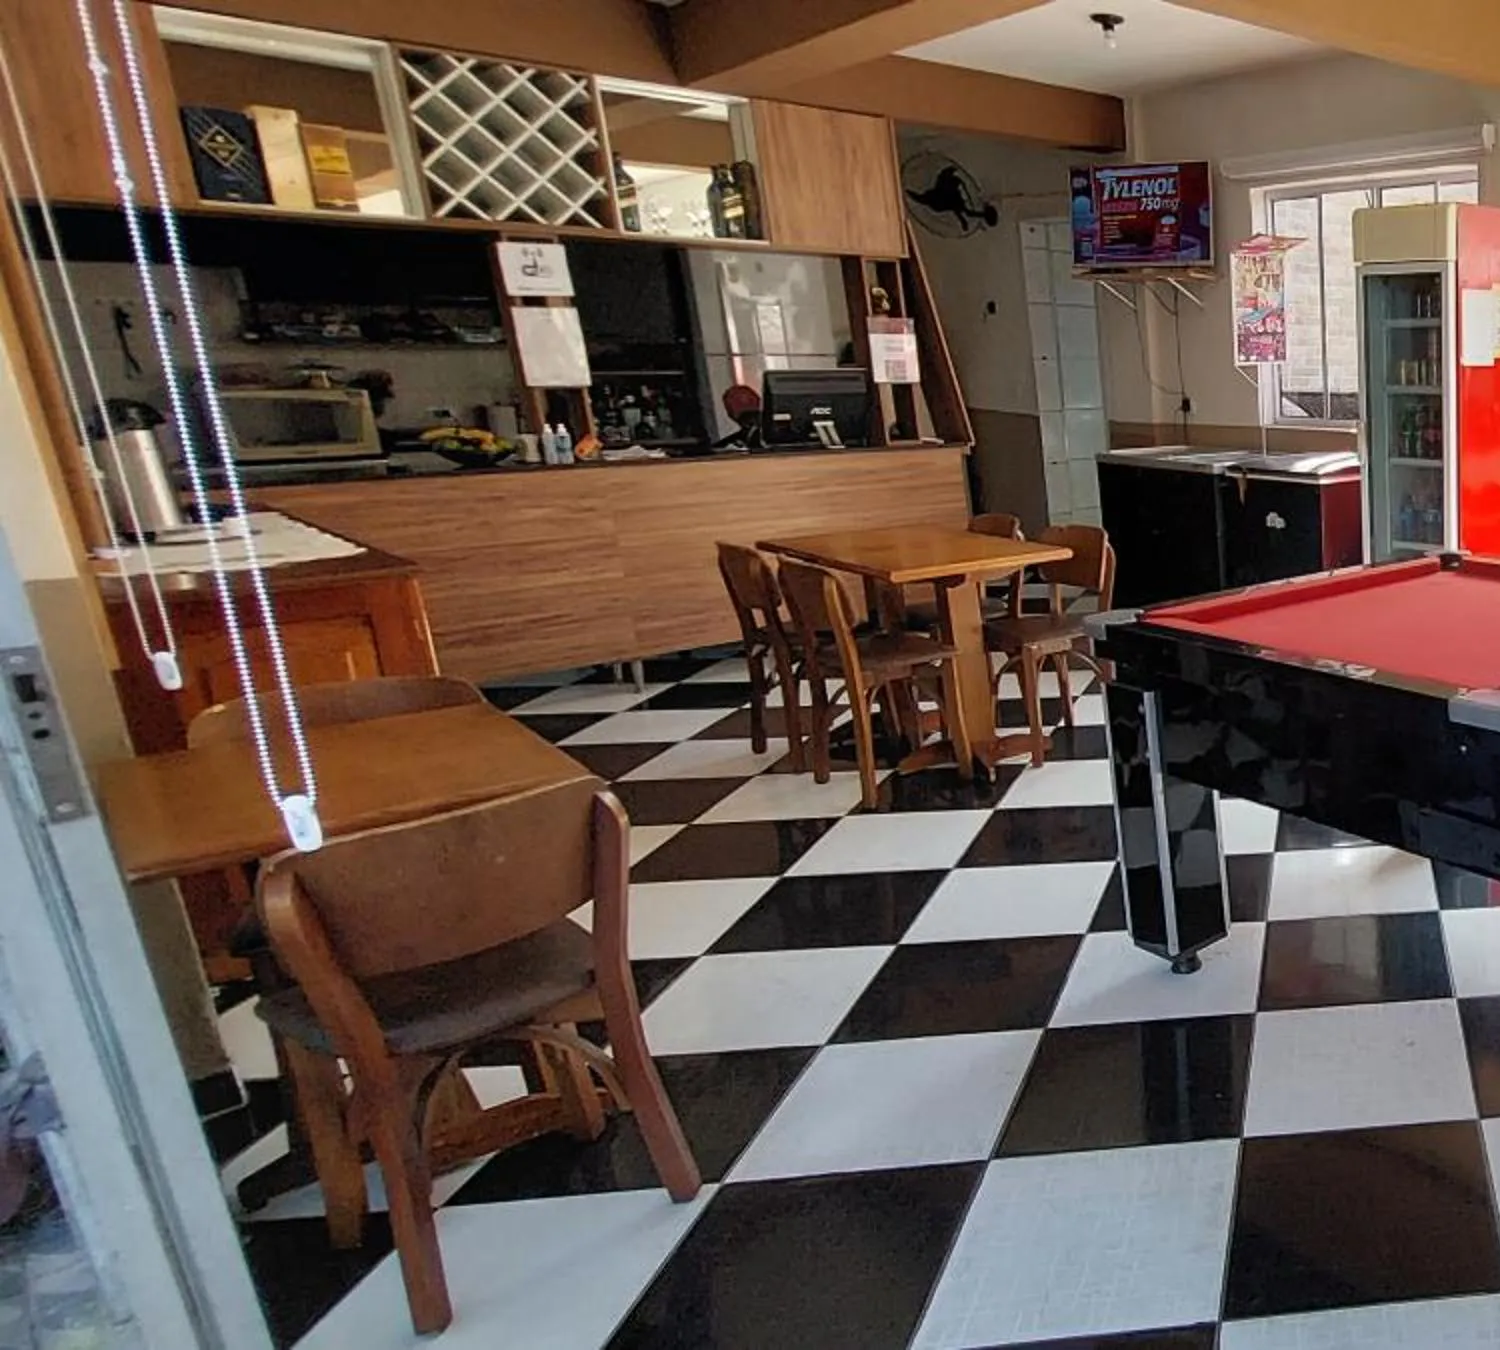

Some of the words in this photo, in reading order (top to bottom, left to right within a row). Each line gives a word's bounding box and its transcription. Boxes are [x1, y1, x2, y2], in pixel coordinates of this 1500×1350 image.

[1100, 176, 1177, 200] TYLENOL
[1140, 197, 1160, 211] 750
[810, 407, 832, 415] AOC
